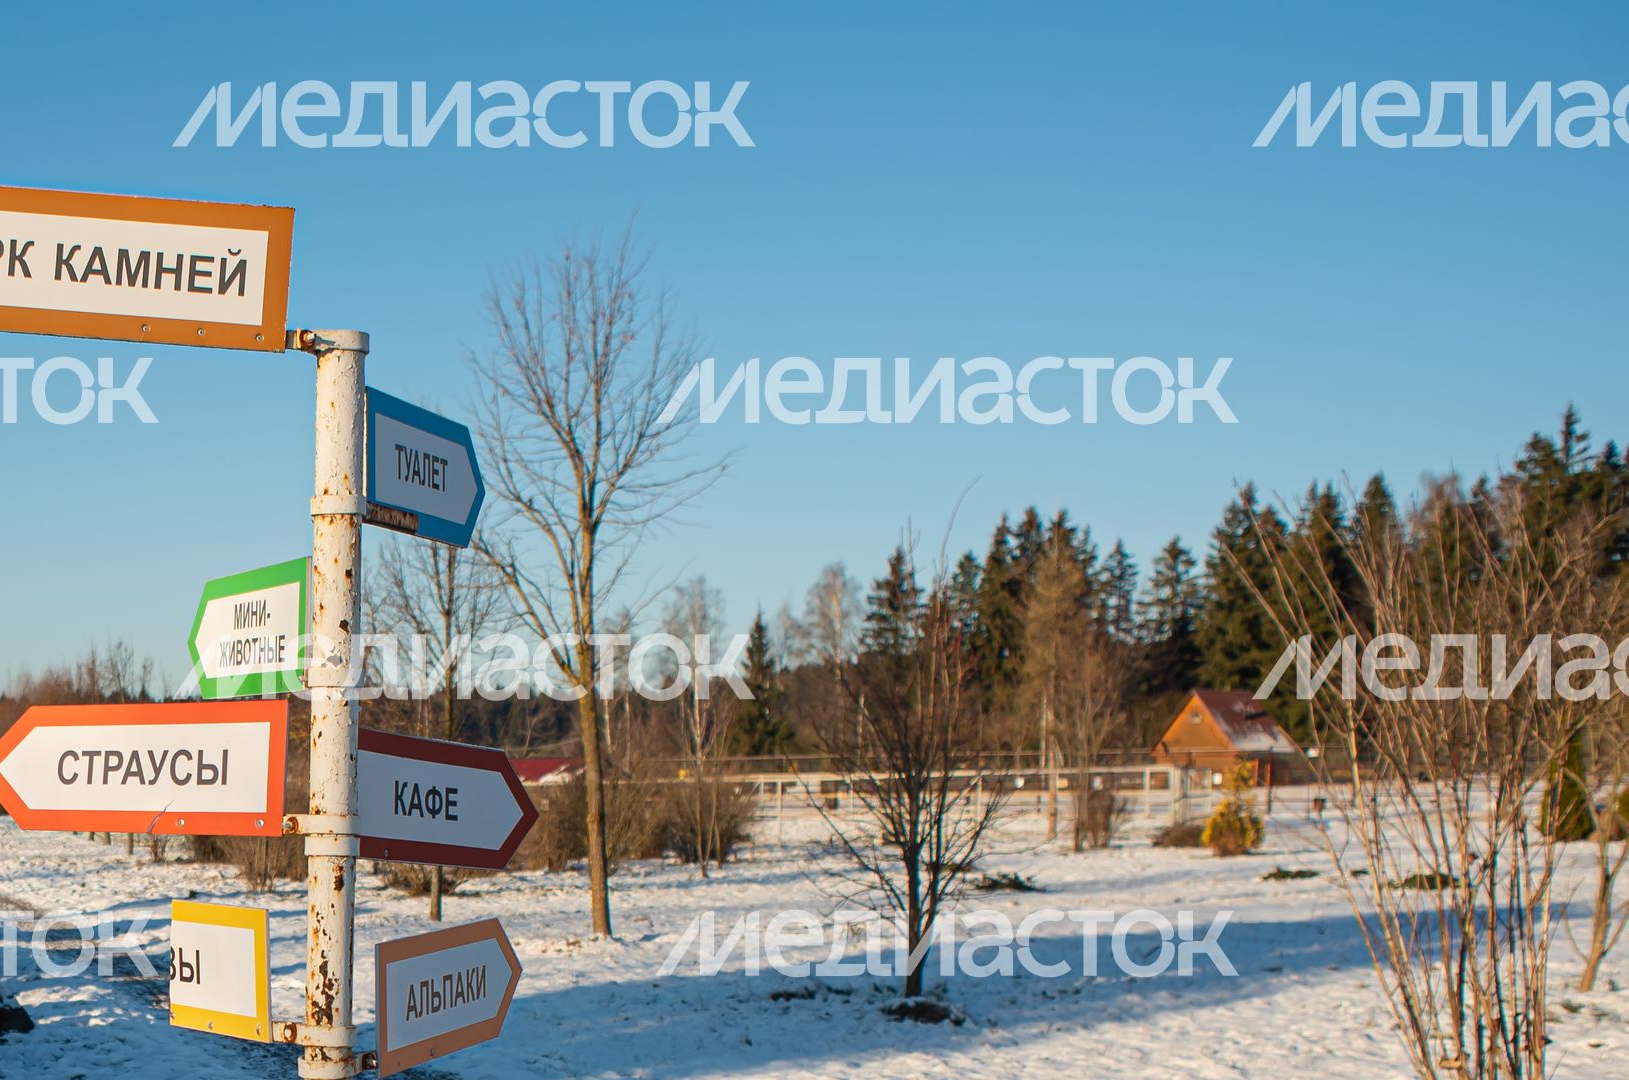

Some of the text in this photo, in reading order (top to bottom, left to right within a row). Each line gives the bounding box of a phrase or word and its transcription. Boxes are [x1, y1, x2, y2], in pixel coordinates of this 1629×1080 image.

[54, 242, 248, 298] КАМНЕЙ
[394, 443, 449, 493] ТУАЛЕТ
[234, 599, 271, 630] МИНИ-
[219, 634, 286, 668] ЖИВОТНЫЕ
[57, 748, 229, 787] СТРАУСЫ
[394, 780, 459, 822] КАФЕ
[405, 964, 487, 1022] АЛЬПАКИ
